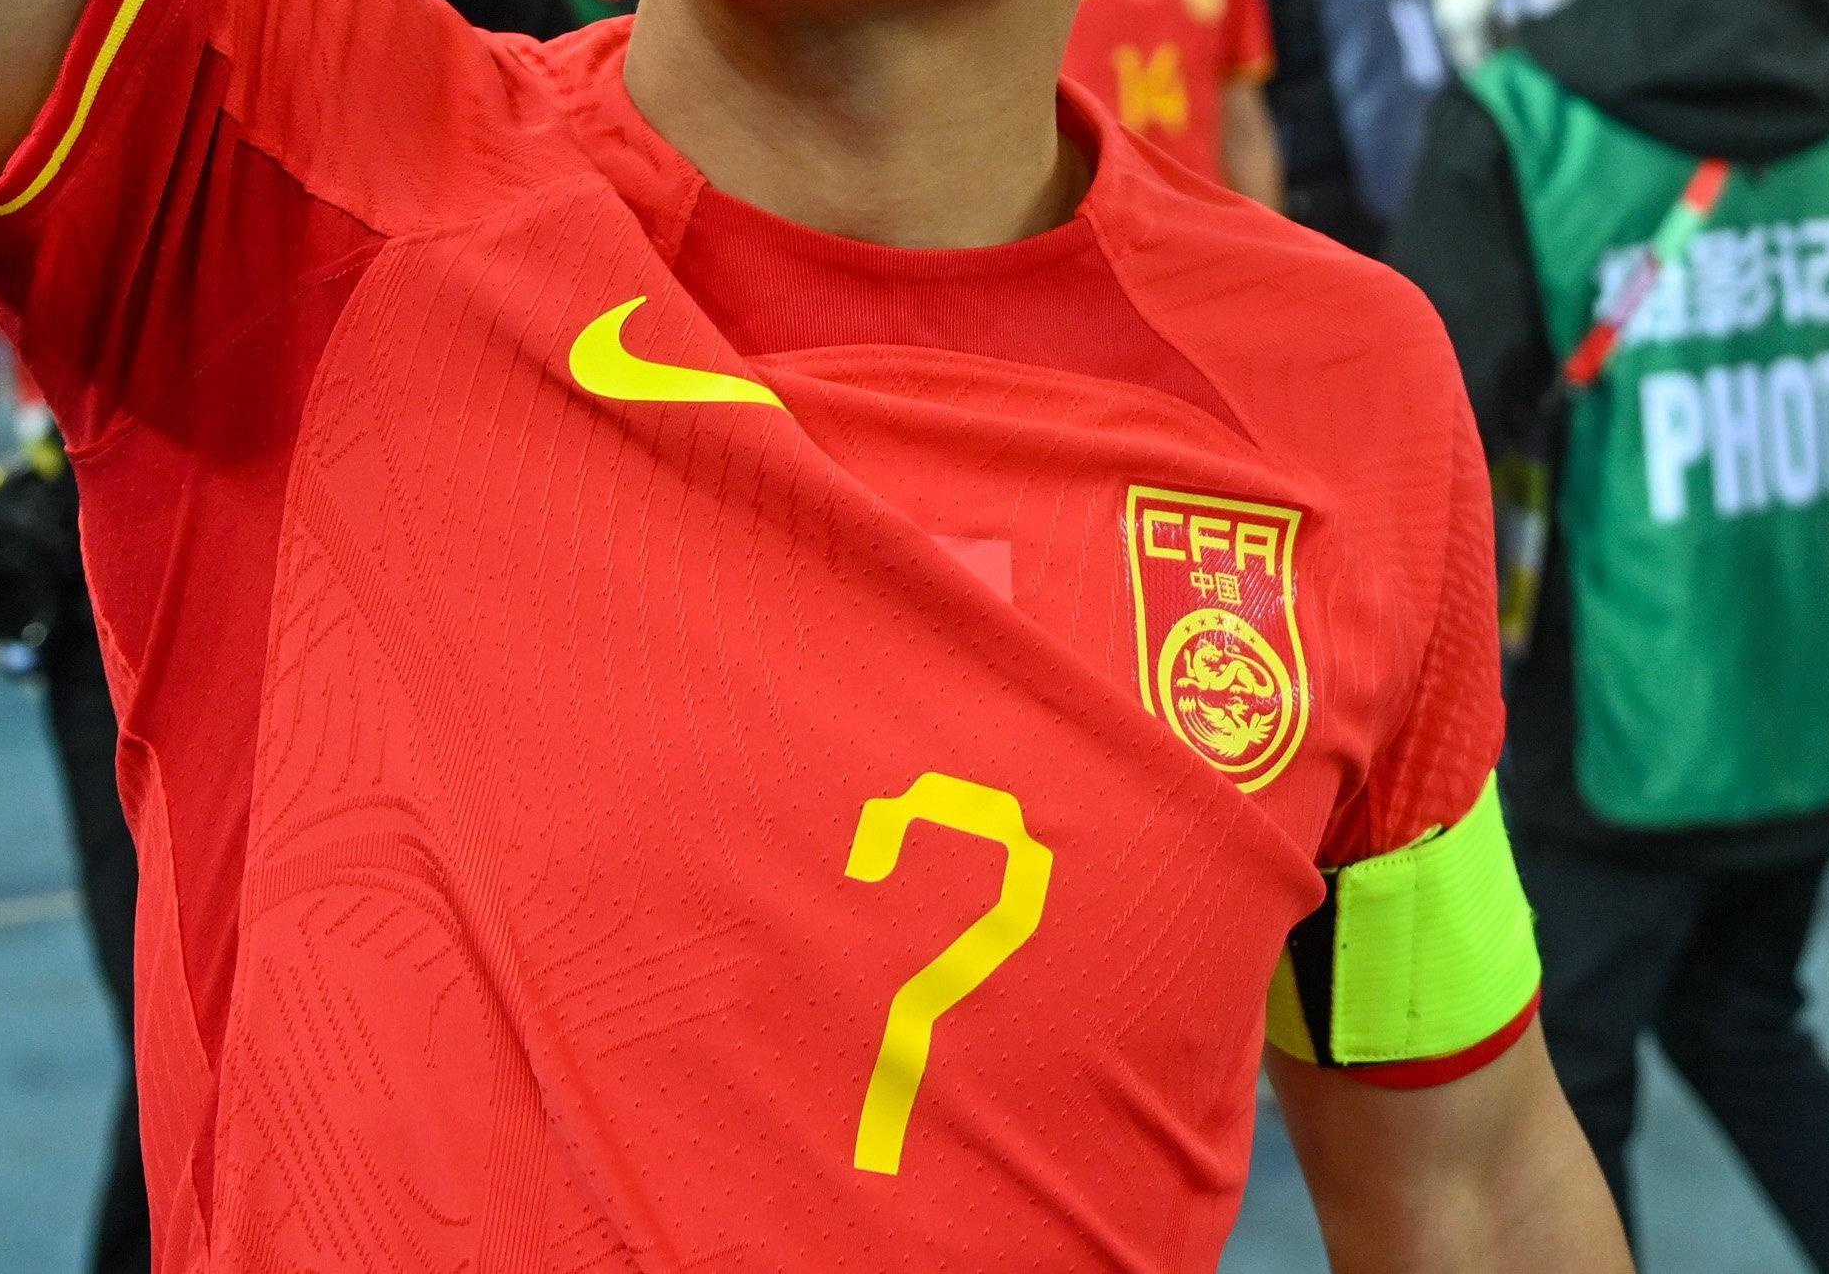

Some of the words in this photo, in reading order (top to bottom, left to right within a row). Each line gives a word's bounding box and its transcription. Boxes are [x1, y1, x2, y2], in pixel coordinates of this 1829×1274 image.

[1143, 508, 1279, 576] CFA
[1189, 568, 1242, 605] 中国
[844, 771, 1053, 1176] 7
